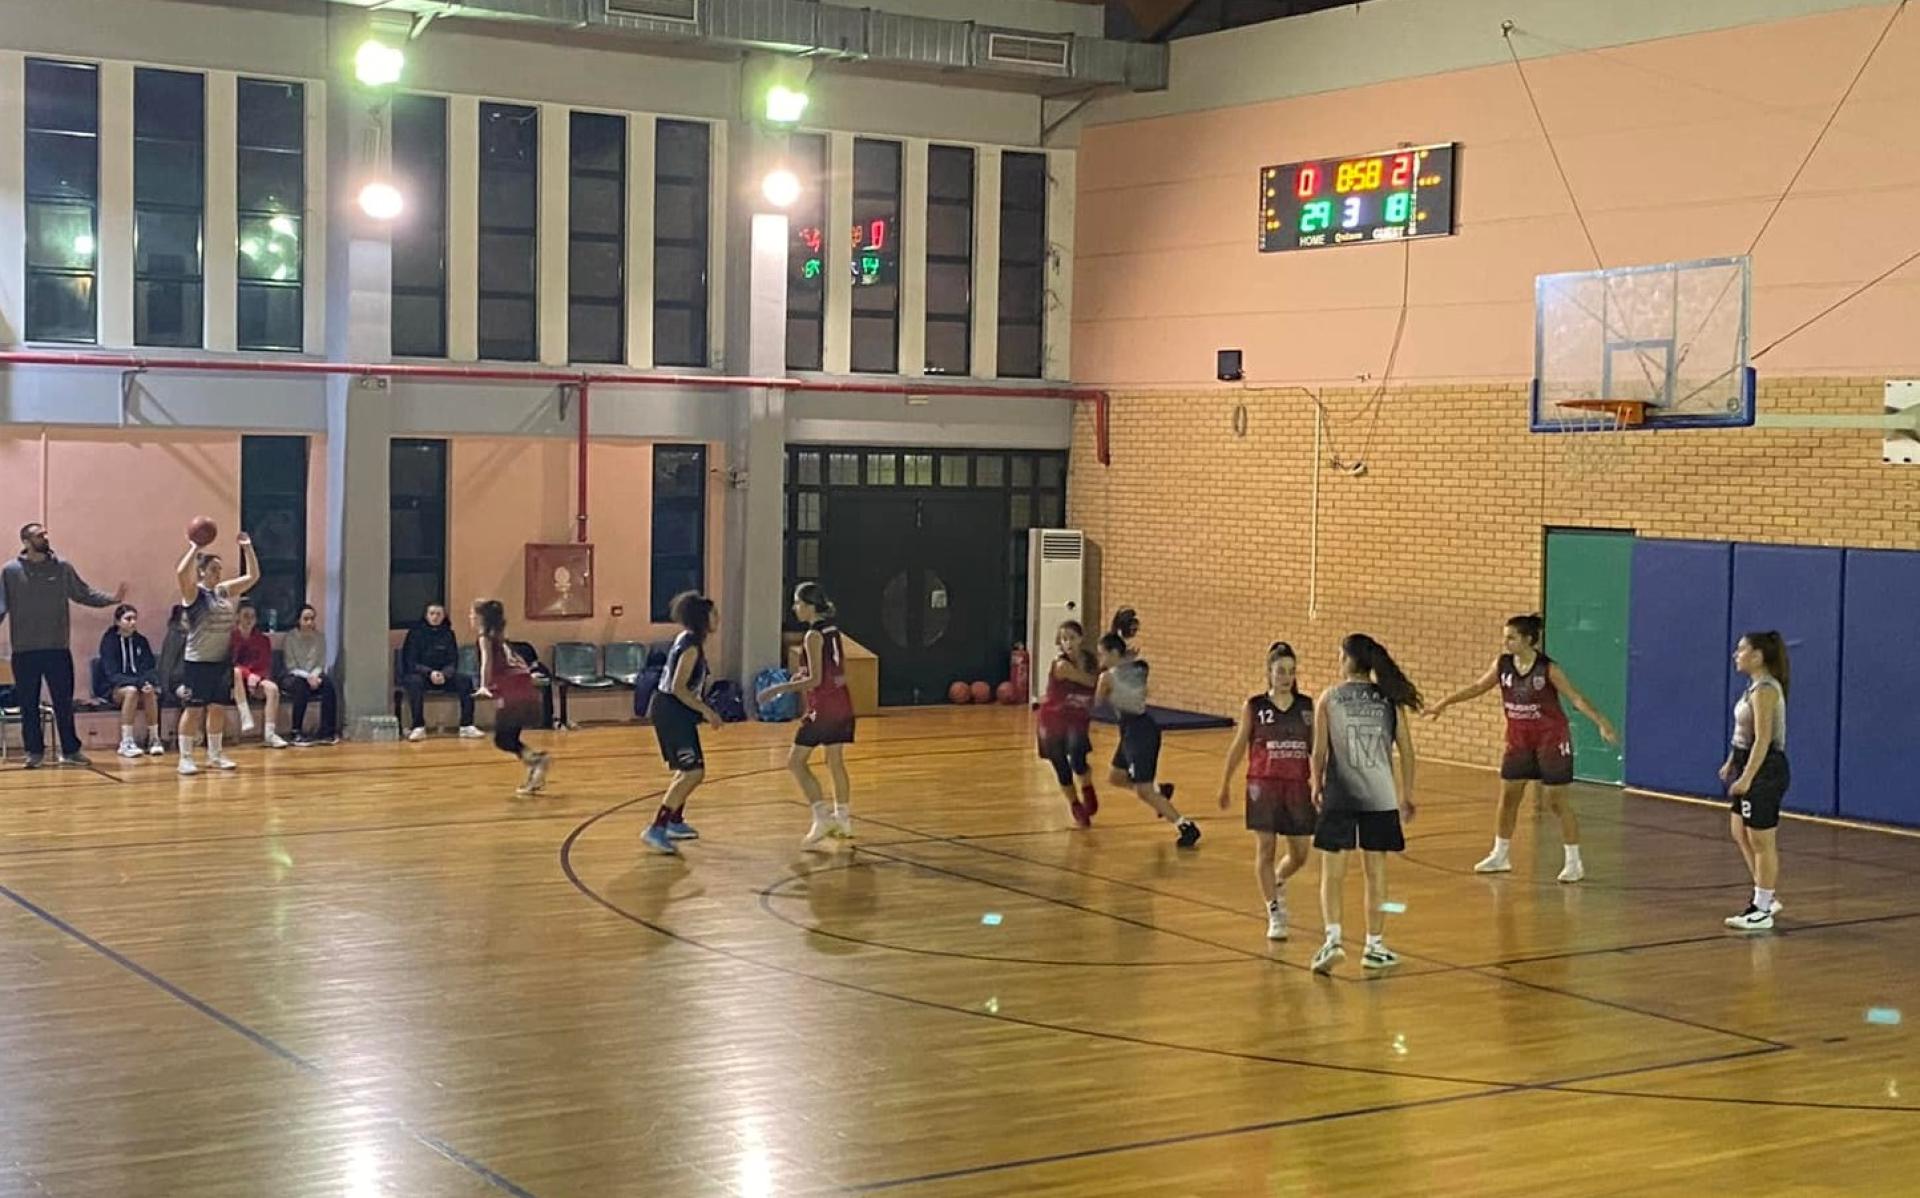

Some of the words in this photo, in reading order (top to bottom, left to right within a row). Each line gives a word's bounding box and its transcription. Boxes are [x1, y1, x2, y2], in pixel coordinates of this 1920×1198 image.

[1298, 168, 1316, 198] 0
[1391, 156, 1409, 187] 2
[1300, 200, 1332, 232] 29
[1341, 197, 1361, 228] 3
[1299, 234, 1326, 248] HOME
[1500, 671, 1513, 688] 14
[1257, 709, 1276, 725] 12
